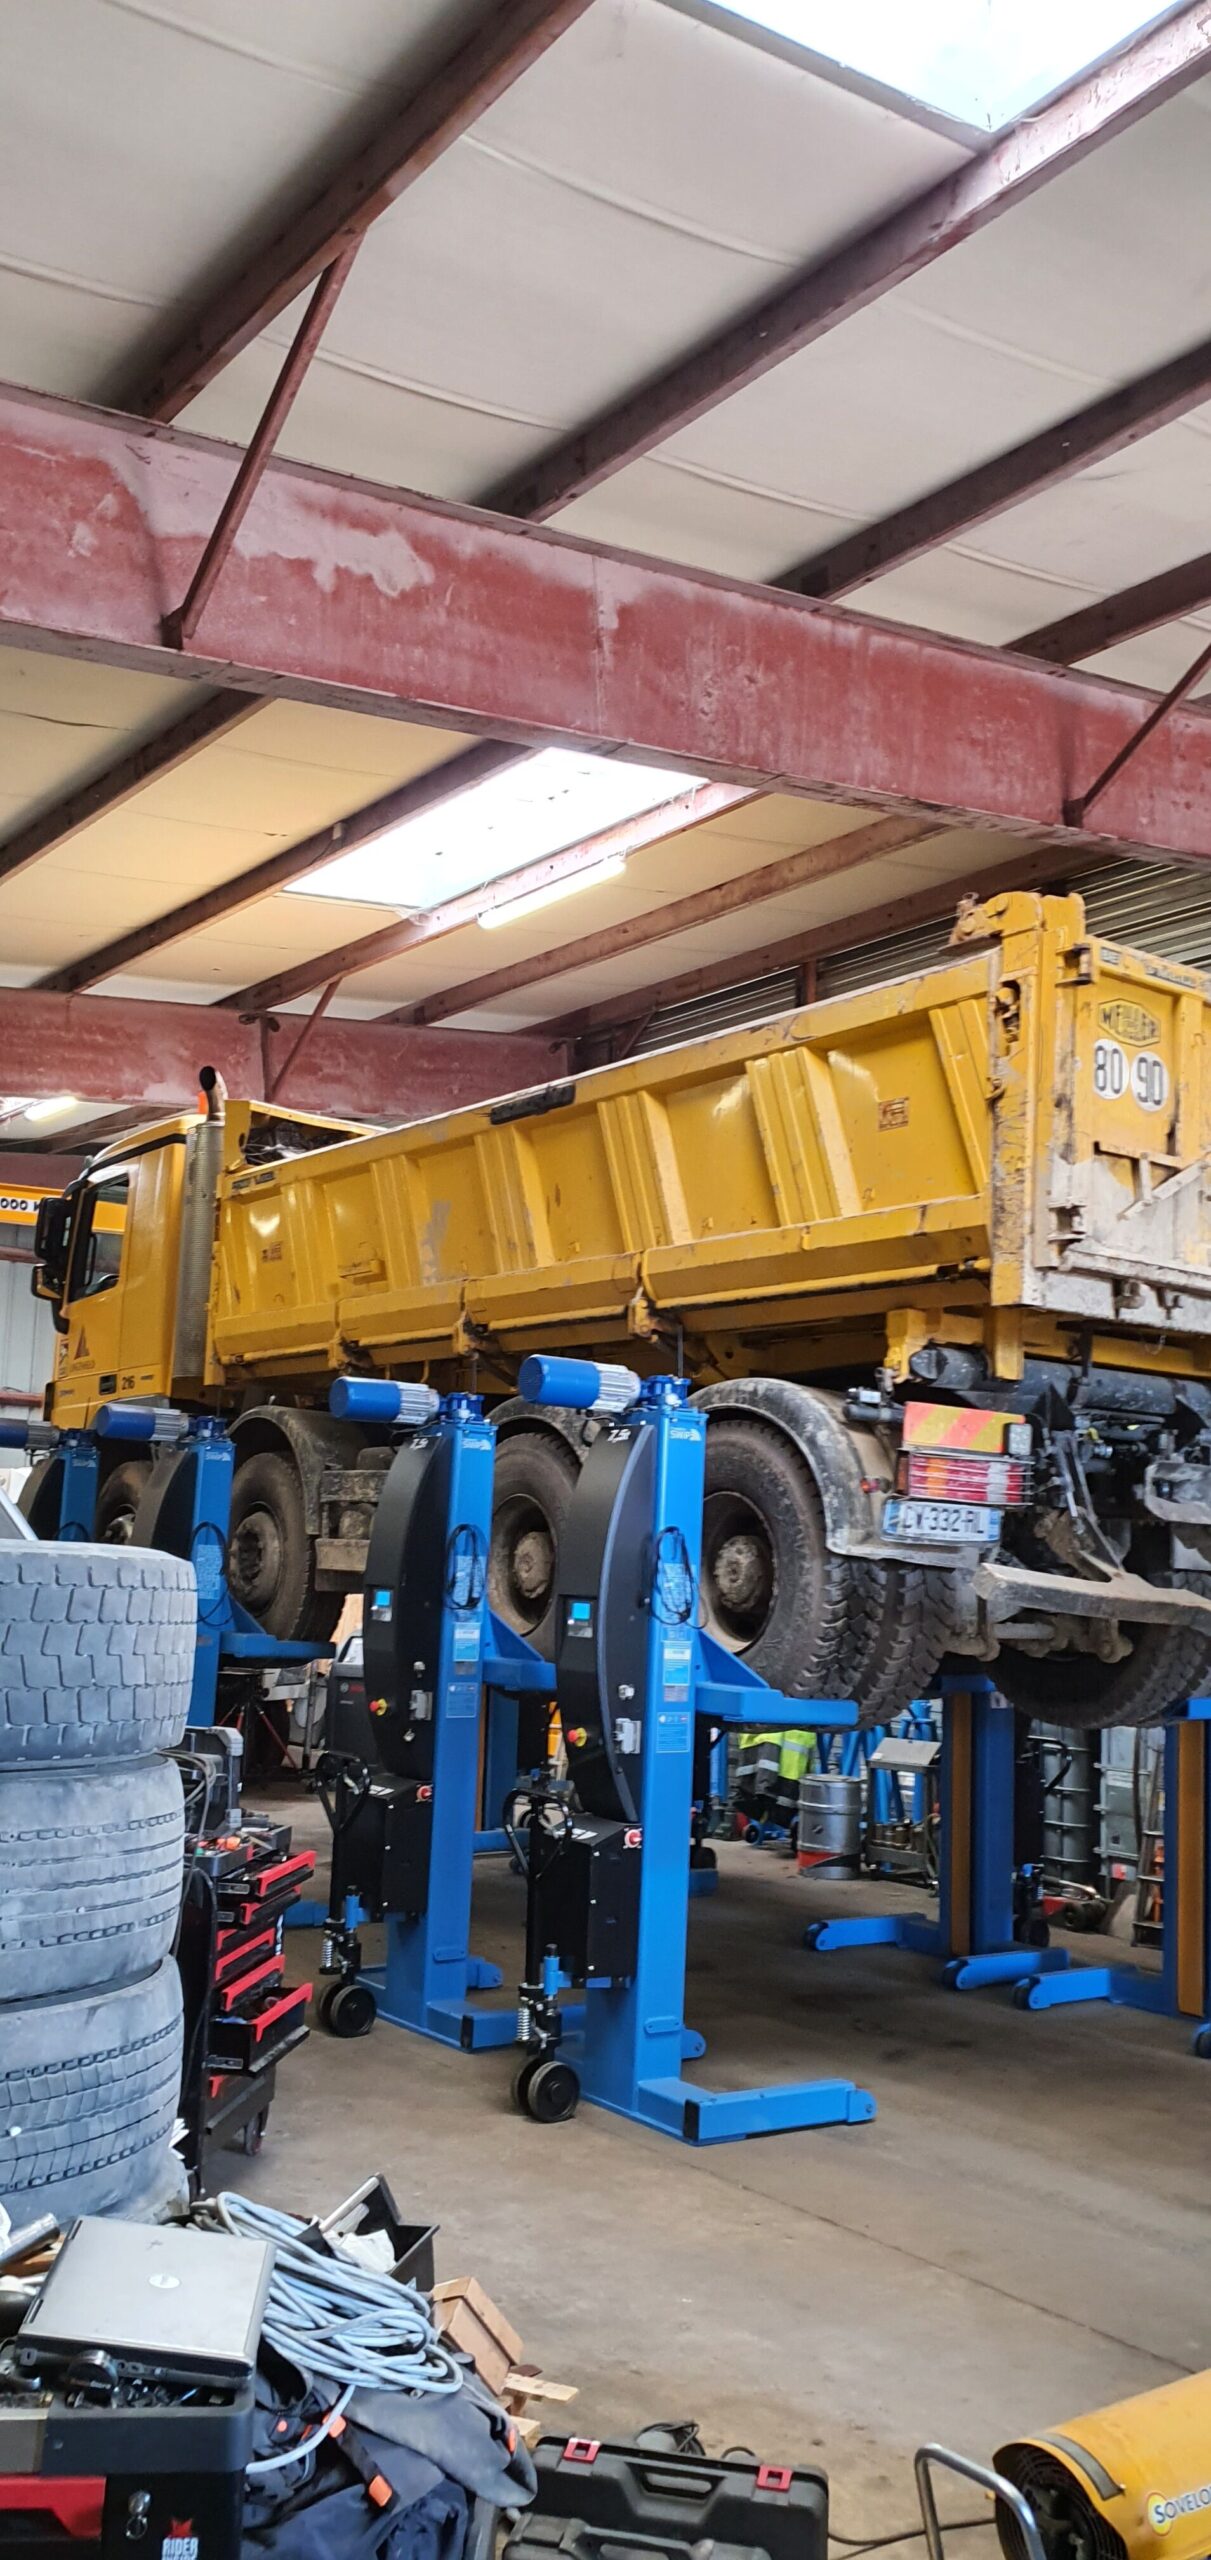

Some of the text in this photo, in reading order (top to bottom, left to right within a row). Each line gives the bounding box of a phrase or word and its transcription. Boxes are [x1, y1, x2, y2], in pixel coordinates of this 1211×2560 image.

[1095, 1045, 1123, 1094] 80
[1137, 1057, 1164, 1106] 90
[1154, 2486, 1211, 2524] SOVELO
[163, 2537, 199, 2554] RIDER
